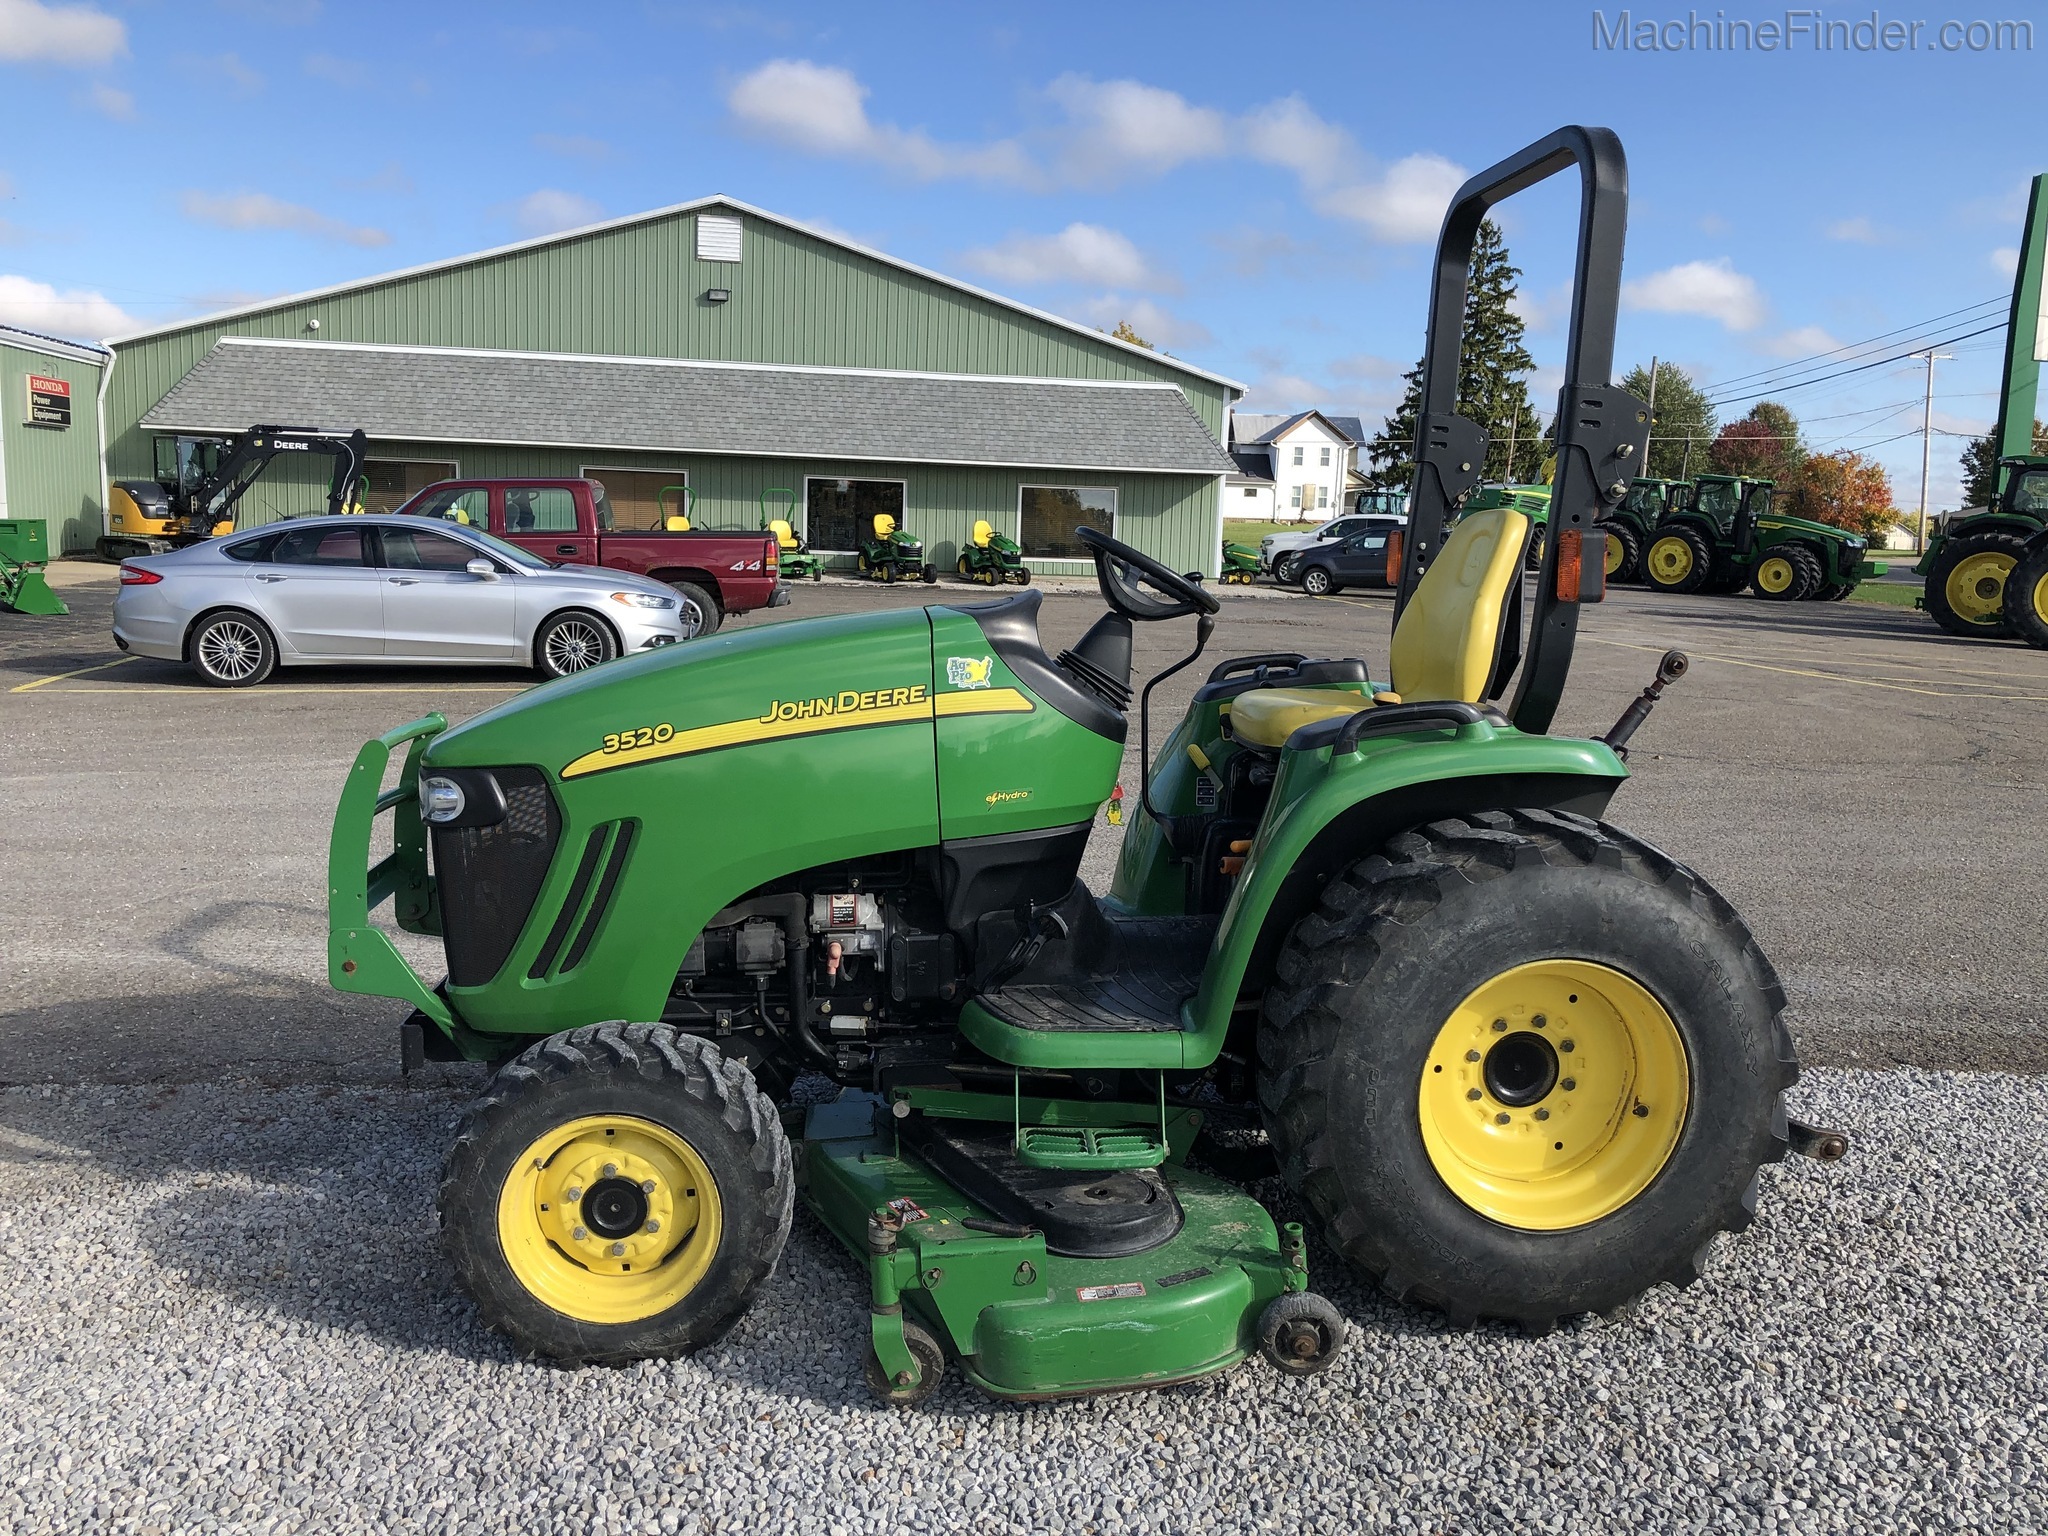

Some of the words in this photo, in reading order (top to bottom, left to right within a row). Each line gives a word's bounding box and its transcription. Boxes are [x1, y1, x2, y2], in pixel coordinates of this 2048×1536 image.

[32, 379, 65, 393] HONDA
[33, 394, 51, 405] Power
[33, 408, 62, 421] Equipment
[273, 440, 309, 451] DEERE
[951, 670, 972, 681] Pro
[760, 696, 835, 723] JOHN
[837, 684, 927, 714] DEERE
[603, 723, 675, 754] 3520
[1688, 939, 1759, 1077] GALAXY
[1364, 1067, 1380, 1127] LUG
